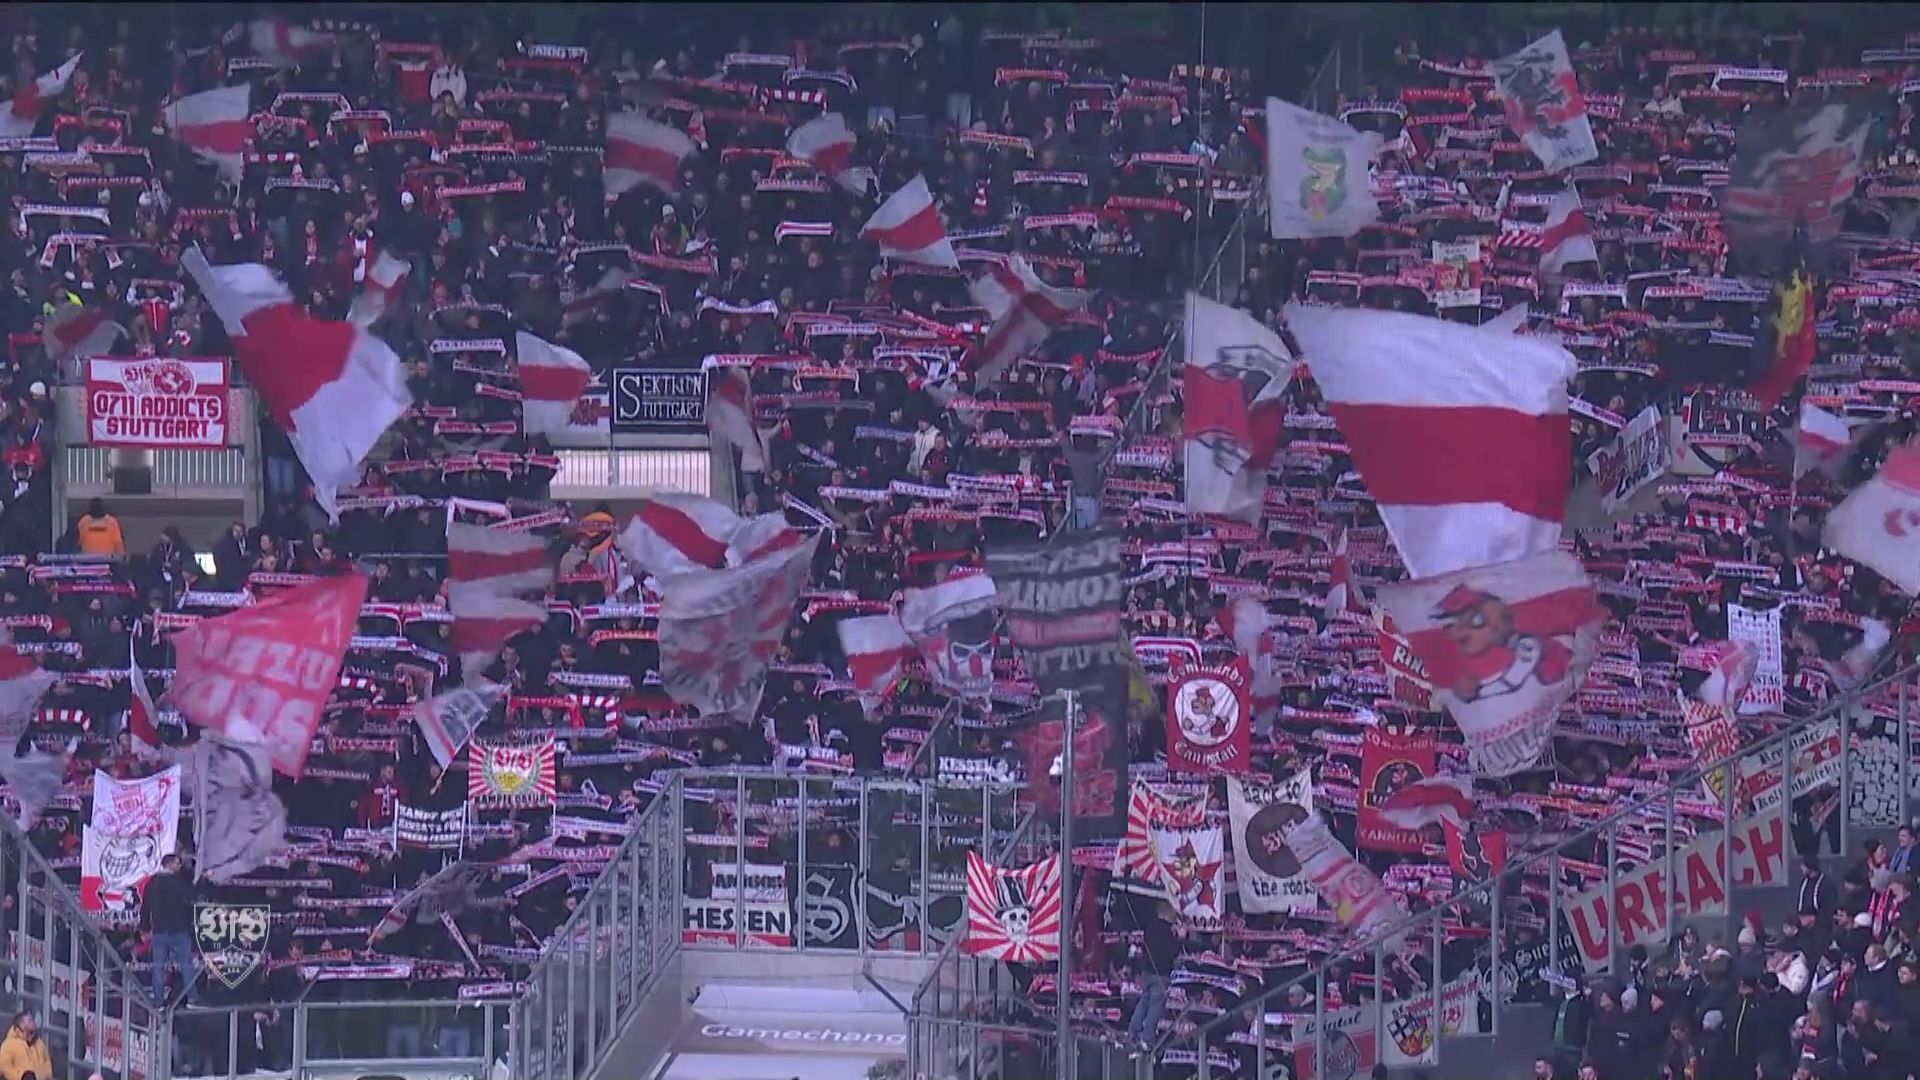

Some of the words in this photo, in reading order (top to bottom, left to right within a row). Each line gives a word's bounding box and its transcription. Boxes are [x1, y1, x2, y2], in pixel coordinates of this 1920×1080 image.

[96, 394, 136, 415] 0711
[141, 396, 219, 417] ADDICTS
[107, 417, 210, 438] STUTTGART
[1252, 877, 1278, 897] the
[1571, 817, 1784, 960] URBACH
[684, 904, 787, 935] HESSEN
